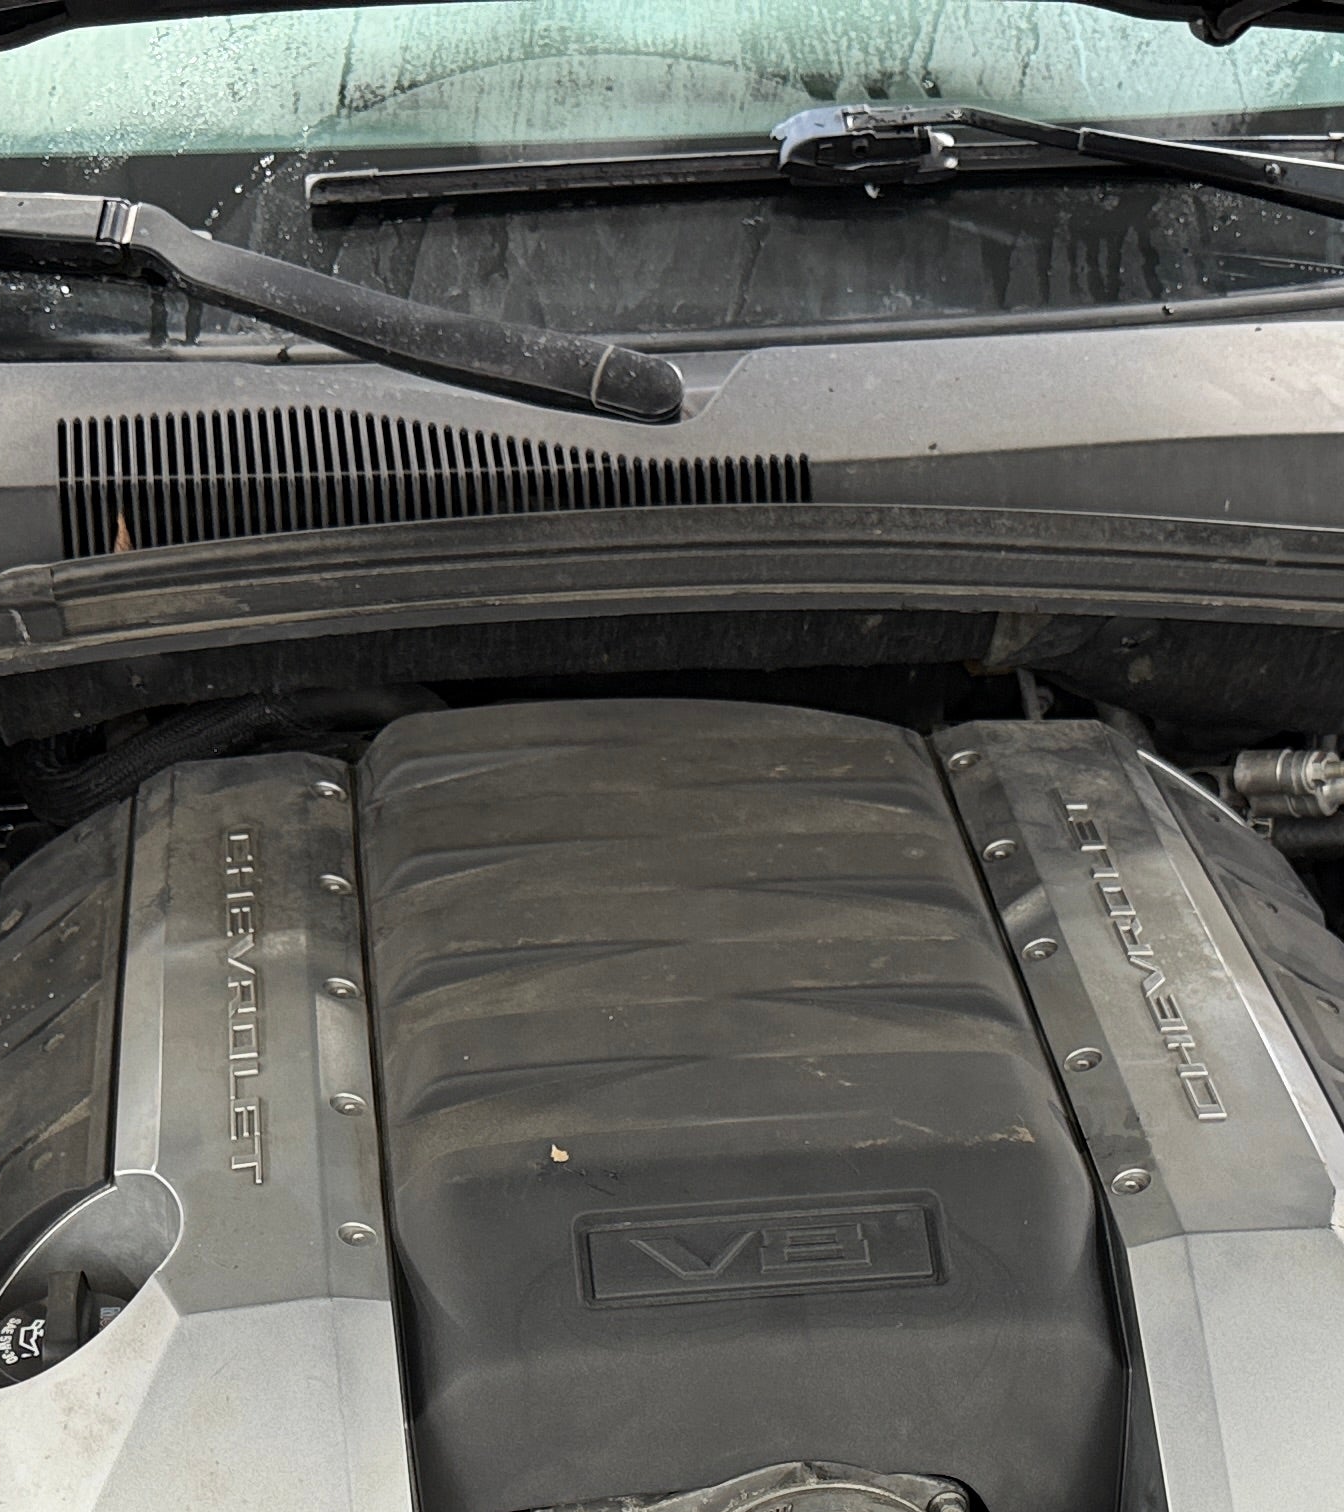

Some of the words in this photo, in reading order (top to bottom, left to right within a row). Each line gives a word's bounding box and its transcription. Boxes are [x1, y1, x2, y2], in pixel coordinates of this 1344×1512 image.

[226, 829, 262, 1184] CHEVROLET
[1051, 788, 1227, 1120] CHEVROLET
[5, 1317, 22, 1334] SAE
[630, 1222, 871, 1281] V8
